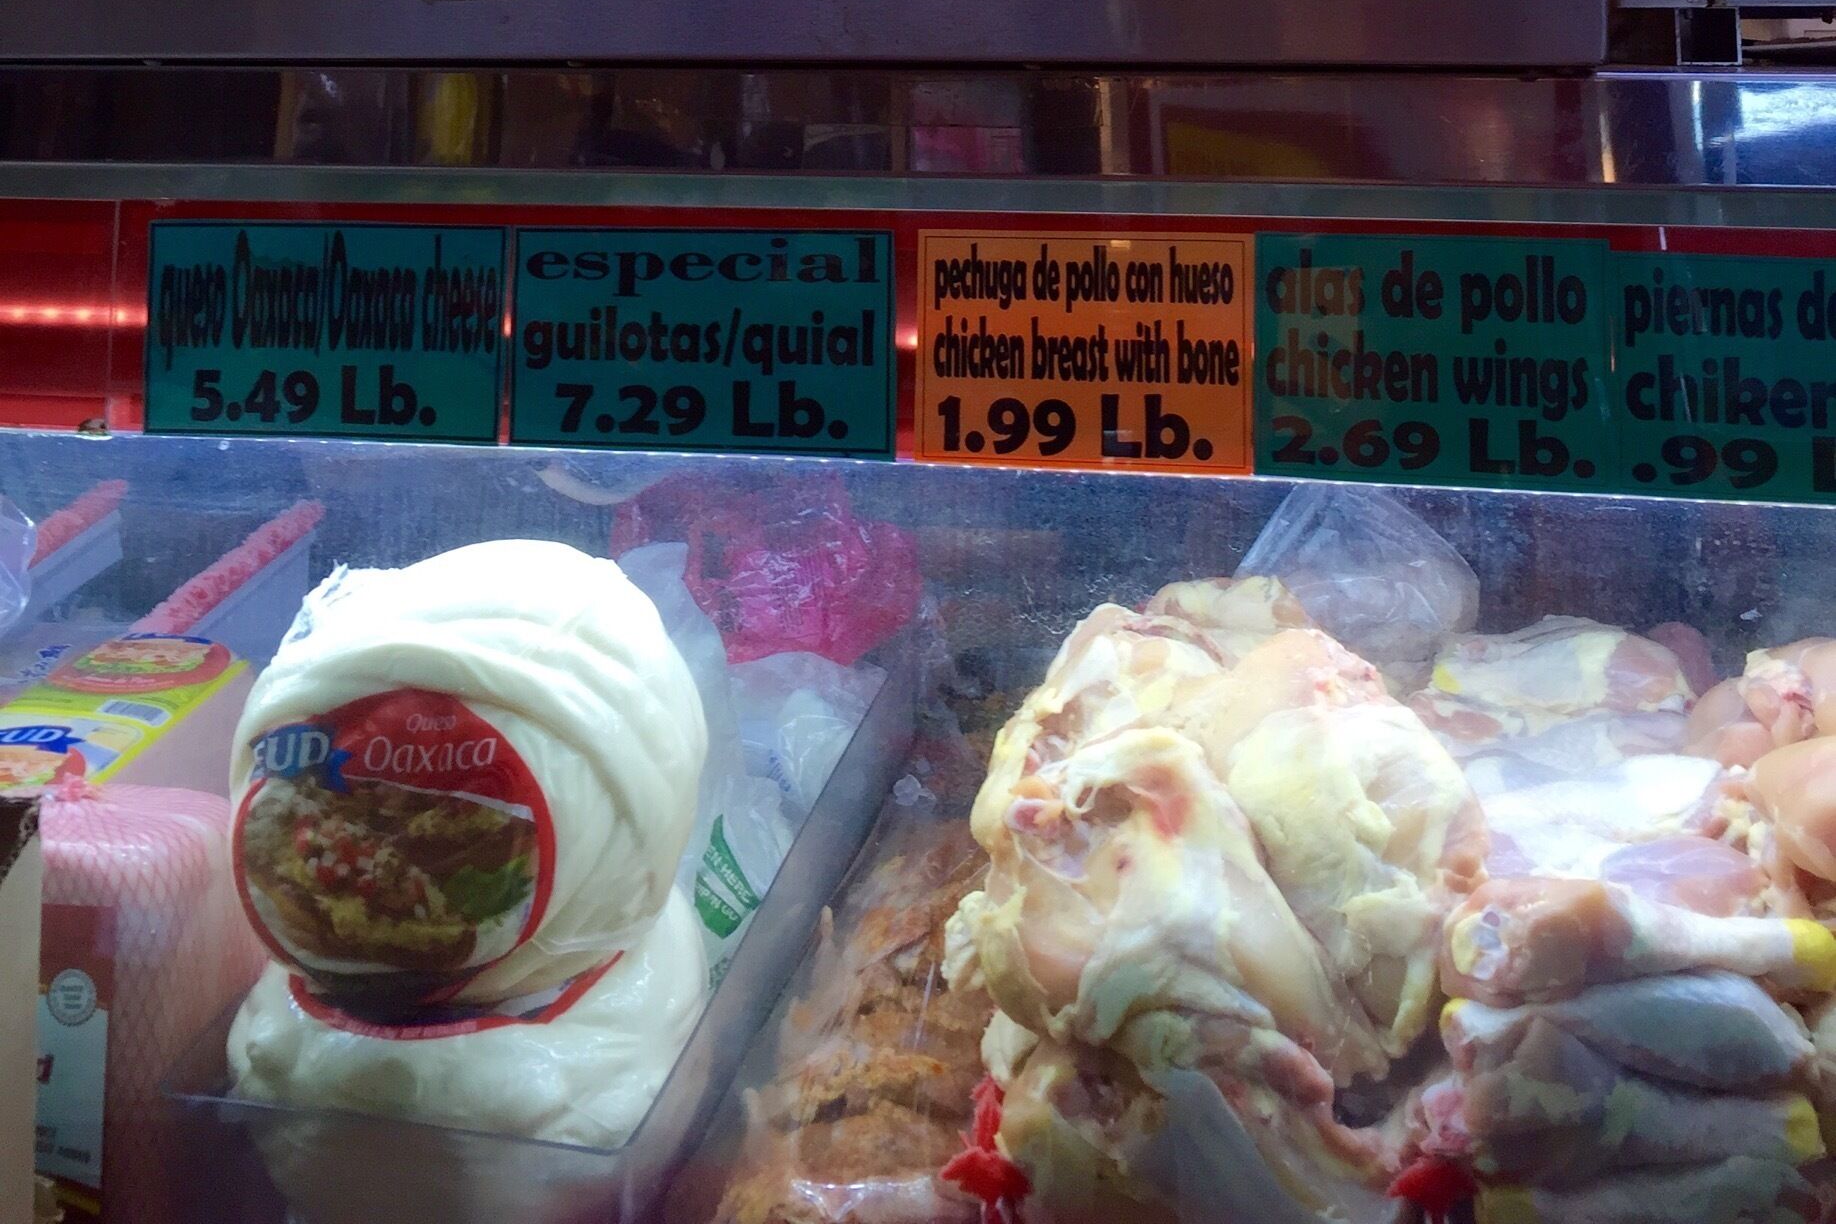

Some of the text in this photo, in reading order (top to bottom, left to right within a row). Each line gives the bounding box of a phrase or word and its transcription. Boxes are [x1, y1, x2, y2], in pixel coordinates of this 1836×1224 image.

[421, 233, 498, 354] cheese
[526, 237, 880, 297] especial
[934, 242, 1234, 313] pechuga de pollo con hueso
[1265, 248, 1587, 335] alas de pollo
[523, 305, 875, 376] guilotas/quial
[1623, 266, 1784, 348] piernas
[933, 314, 1240, 387] chicken breast with bone
[1266, 327, 1589, 422] chicken wings
[190, 364, 438, 426] 5.49 Lb.
[554, 379, 849, 440] 7.29 Lb.
[937, 393, 1214, 461] 1.99 Lb.
[1271, 415, 1597, 479] 2.69 Lb.
[1631, 434, 1779, 490] .99
[0, 729, 65, 743] UD
[363, 735, 494, 774] Oaxaca
